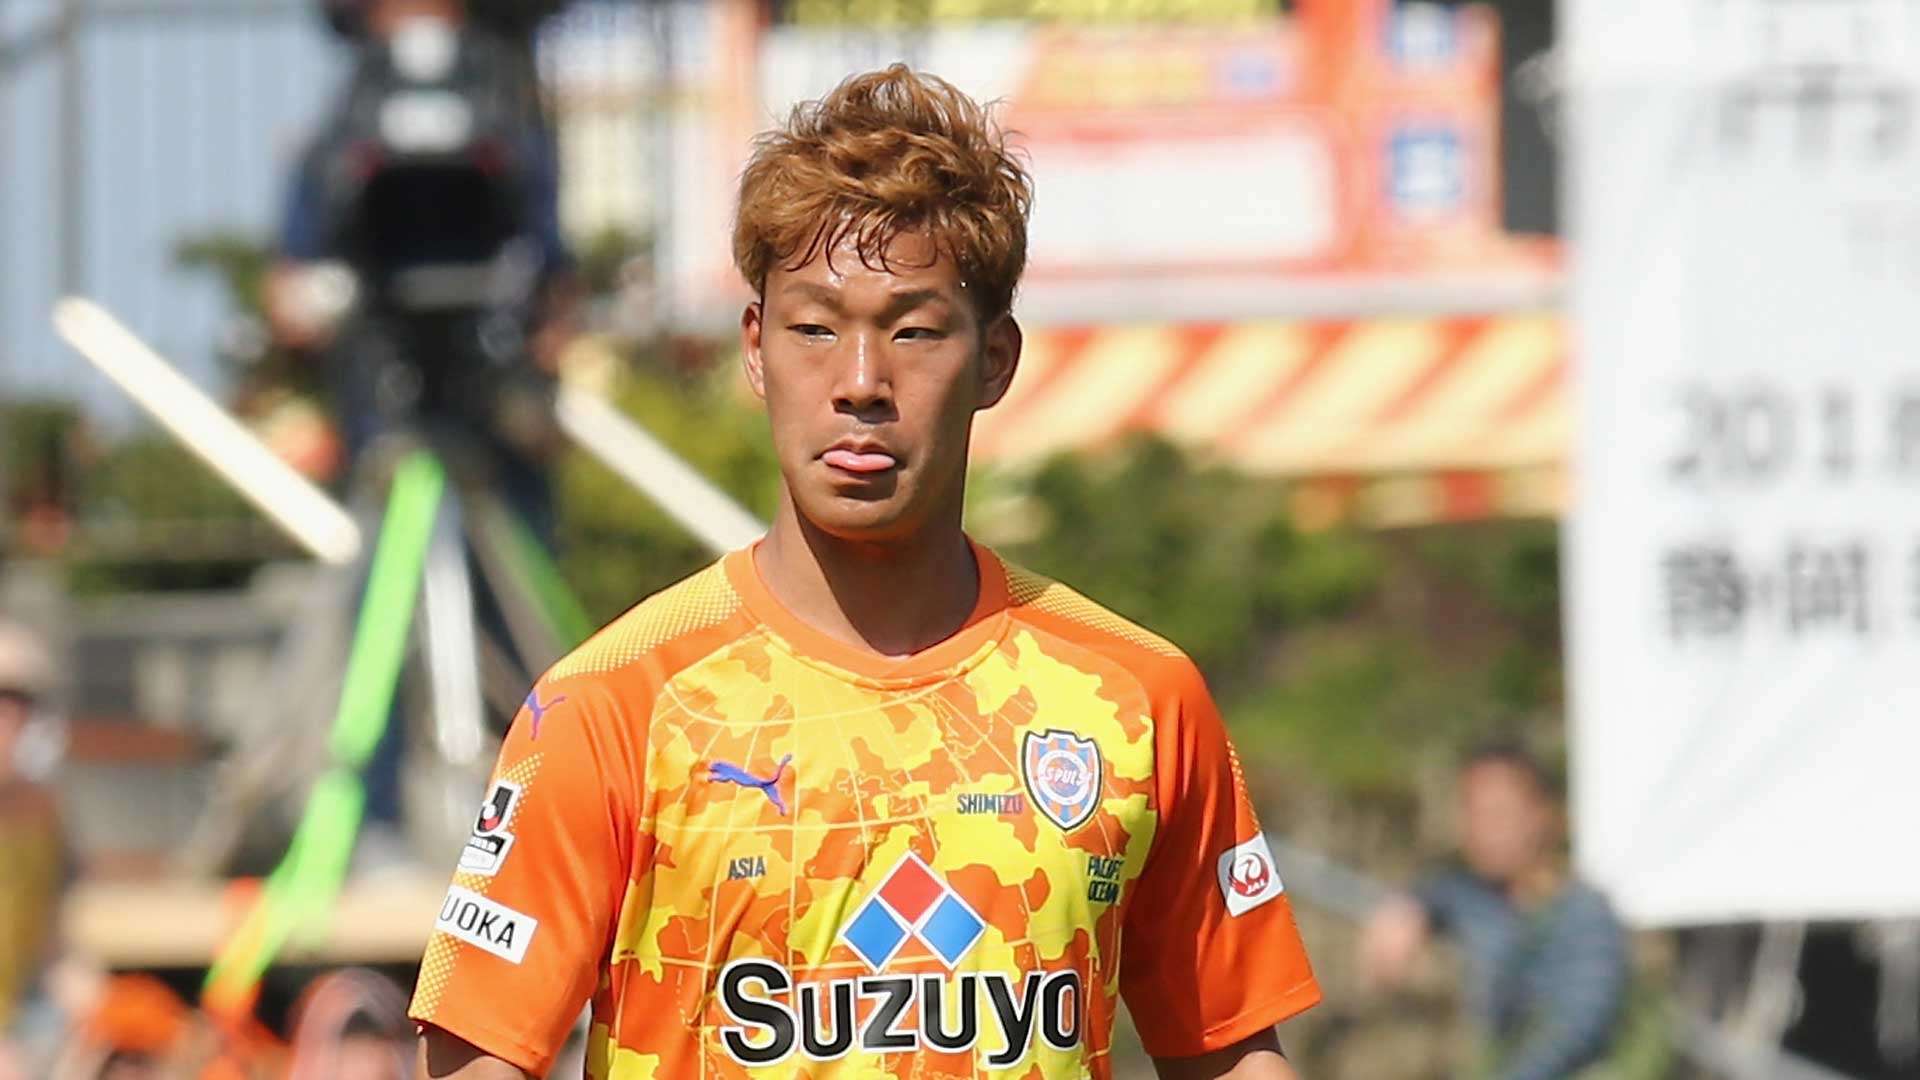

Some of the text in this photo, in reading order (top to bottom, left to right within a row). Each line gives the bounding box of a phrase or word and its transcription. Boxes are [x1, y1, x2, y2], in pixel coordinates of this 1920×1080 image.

[957, 793, 1024, 814] SHIMIZU
[728, 857, 766, 880] ASIA
[720, 960, 1082, 1066] Suzuyo
